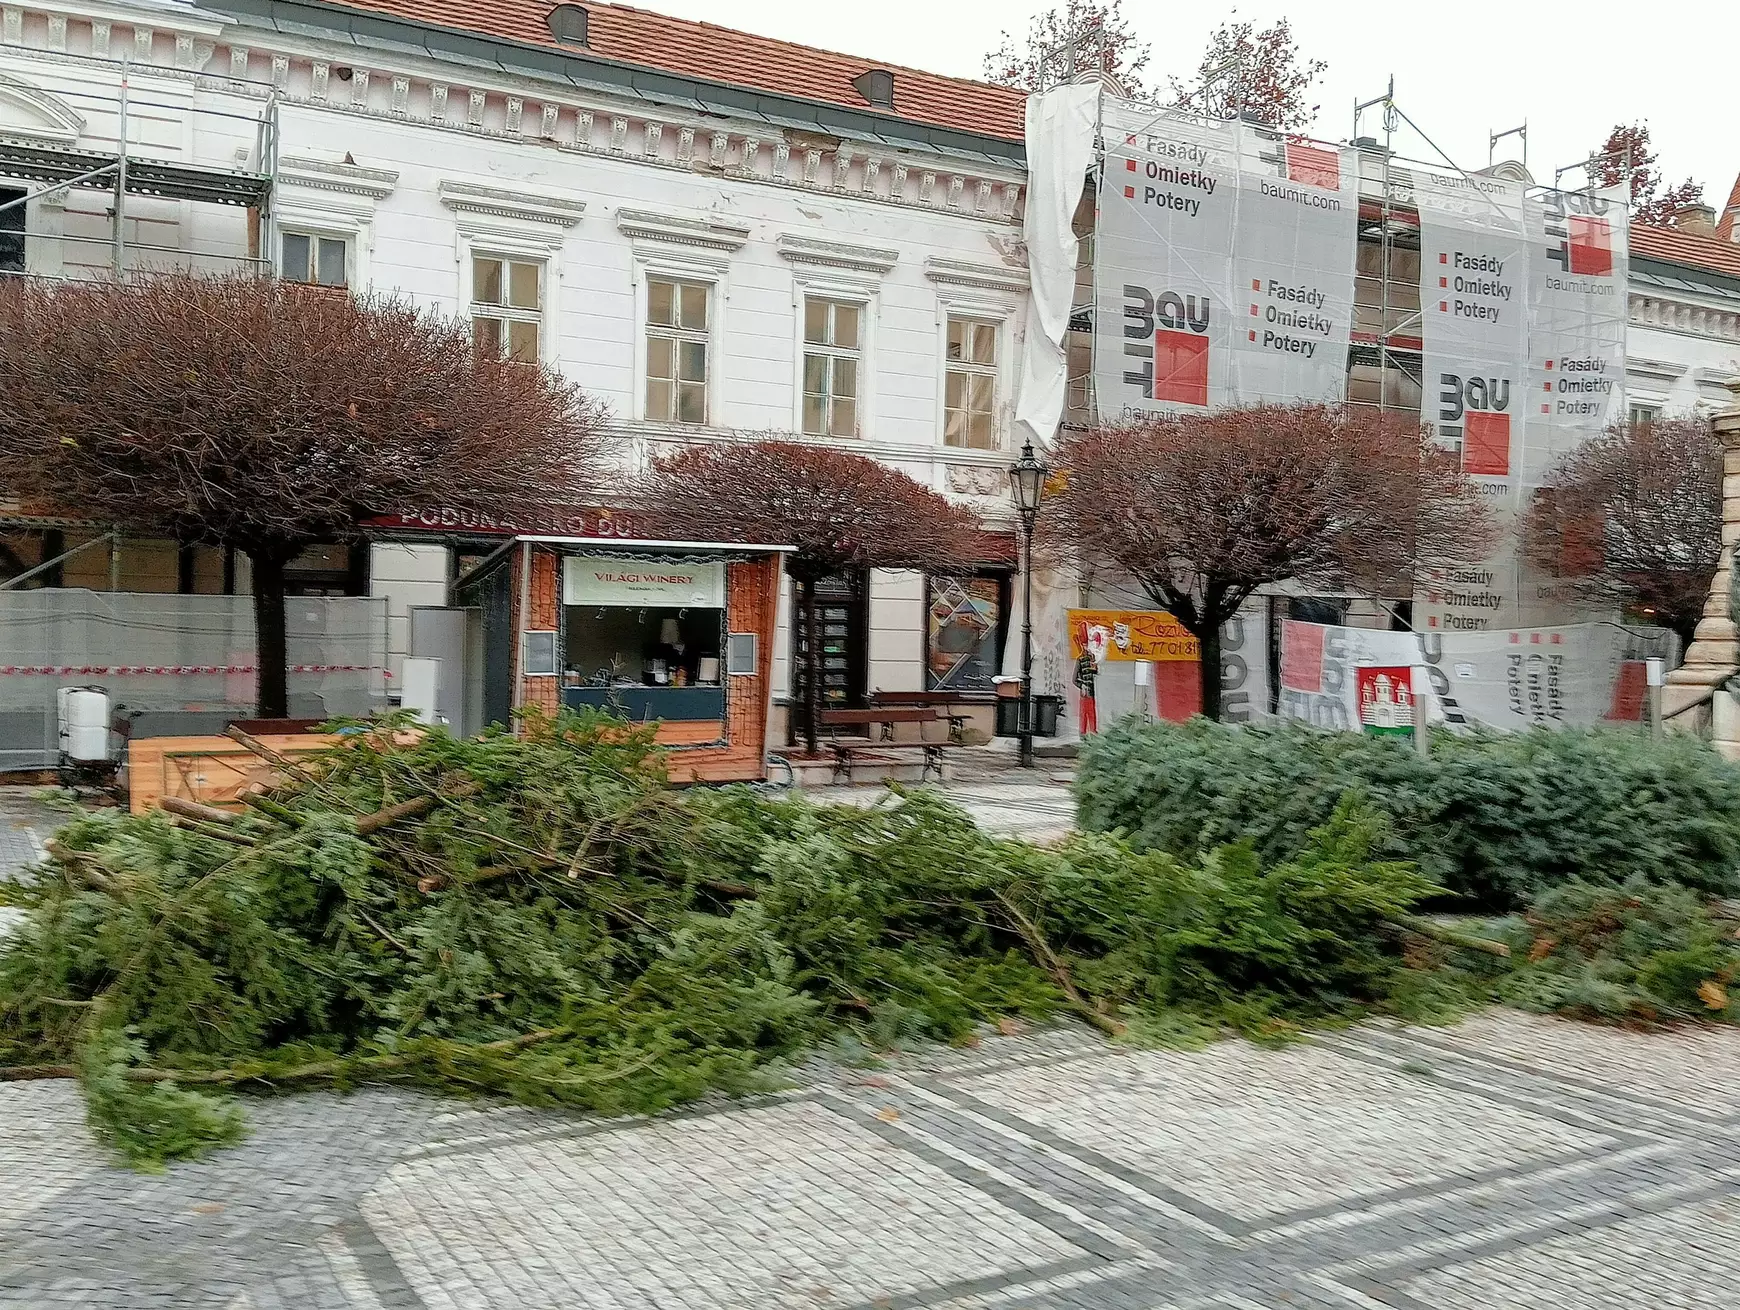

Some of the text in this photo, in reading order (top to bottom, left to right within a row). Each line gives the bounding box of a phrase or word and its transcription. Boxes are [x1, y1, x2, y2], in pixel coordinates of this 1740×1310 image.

[1147, 134, 1208, 167] Fasády
[1145, 160, 1217, 195] Omietky
[1430, 173, 1506, 195] baumit.com
[1144, 186, 1201, 217] Potery
[1260, 179, 1341, 211] baumit.com
[1454, 251, 1504, 277] Fasády
[1267, 278, 1326, 309] Fasády
[1454, 275, 1512, 301] Omietky
[1545, 274, 1615, 296] baumit.com
[1265, 305, 1333, 336] Omietky
[1454, 300, 1500, 323] Potery
[1262, 329, 1317, 358] Potery
[1559, 356, 1607, 374] Fasády
[1558, 377, 1613, 394] Omietky
[1556, 399, 1600, 416] Potery
[595, 571, 694, 584] VILÁGI WINERY
[1444, 590, 1502, 610] Omietky
[1443, 613, 1489, 631] Potery
[1507, 654, 1526, 716] Potery
